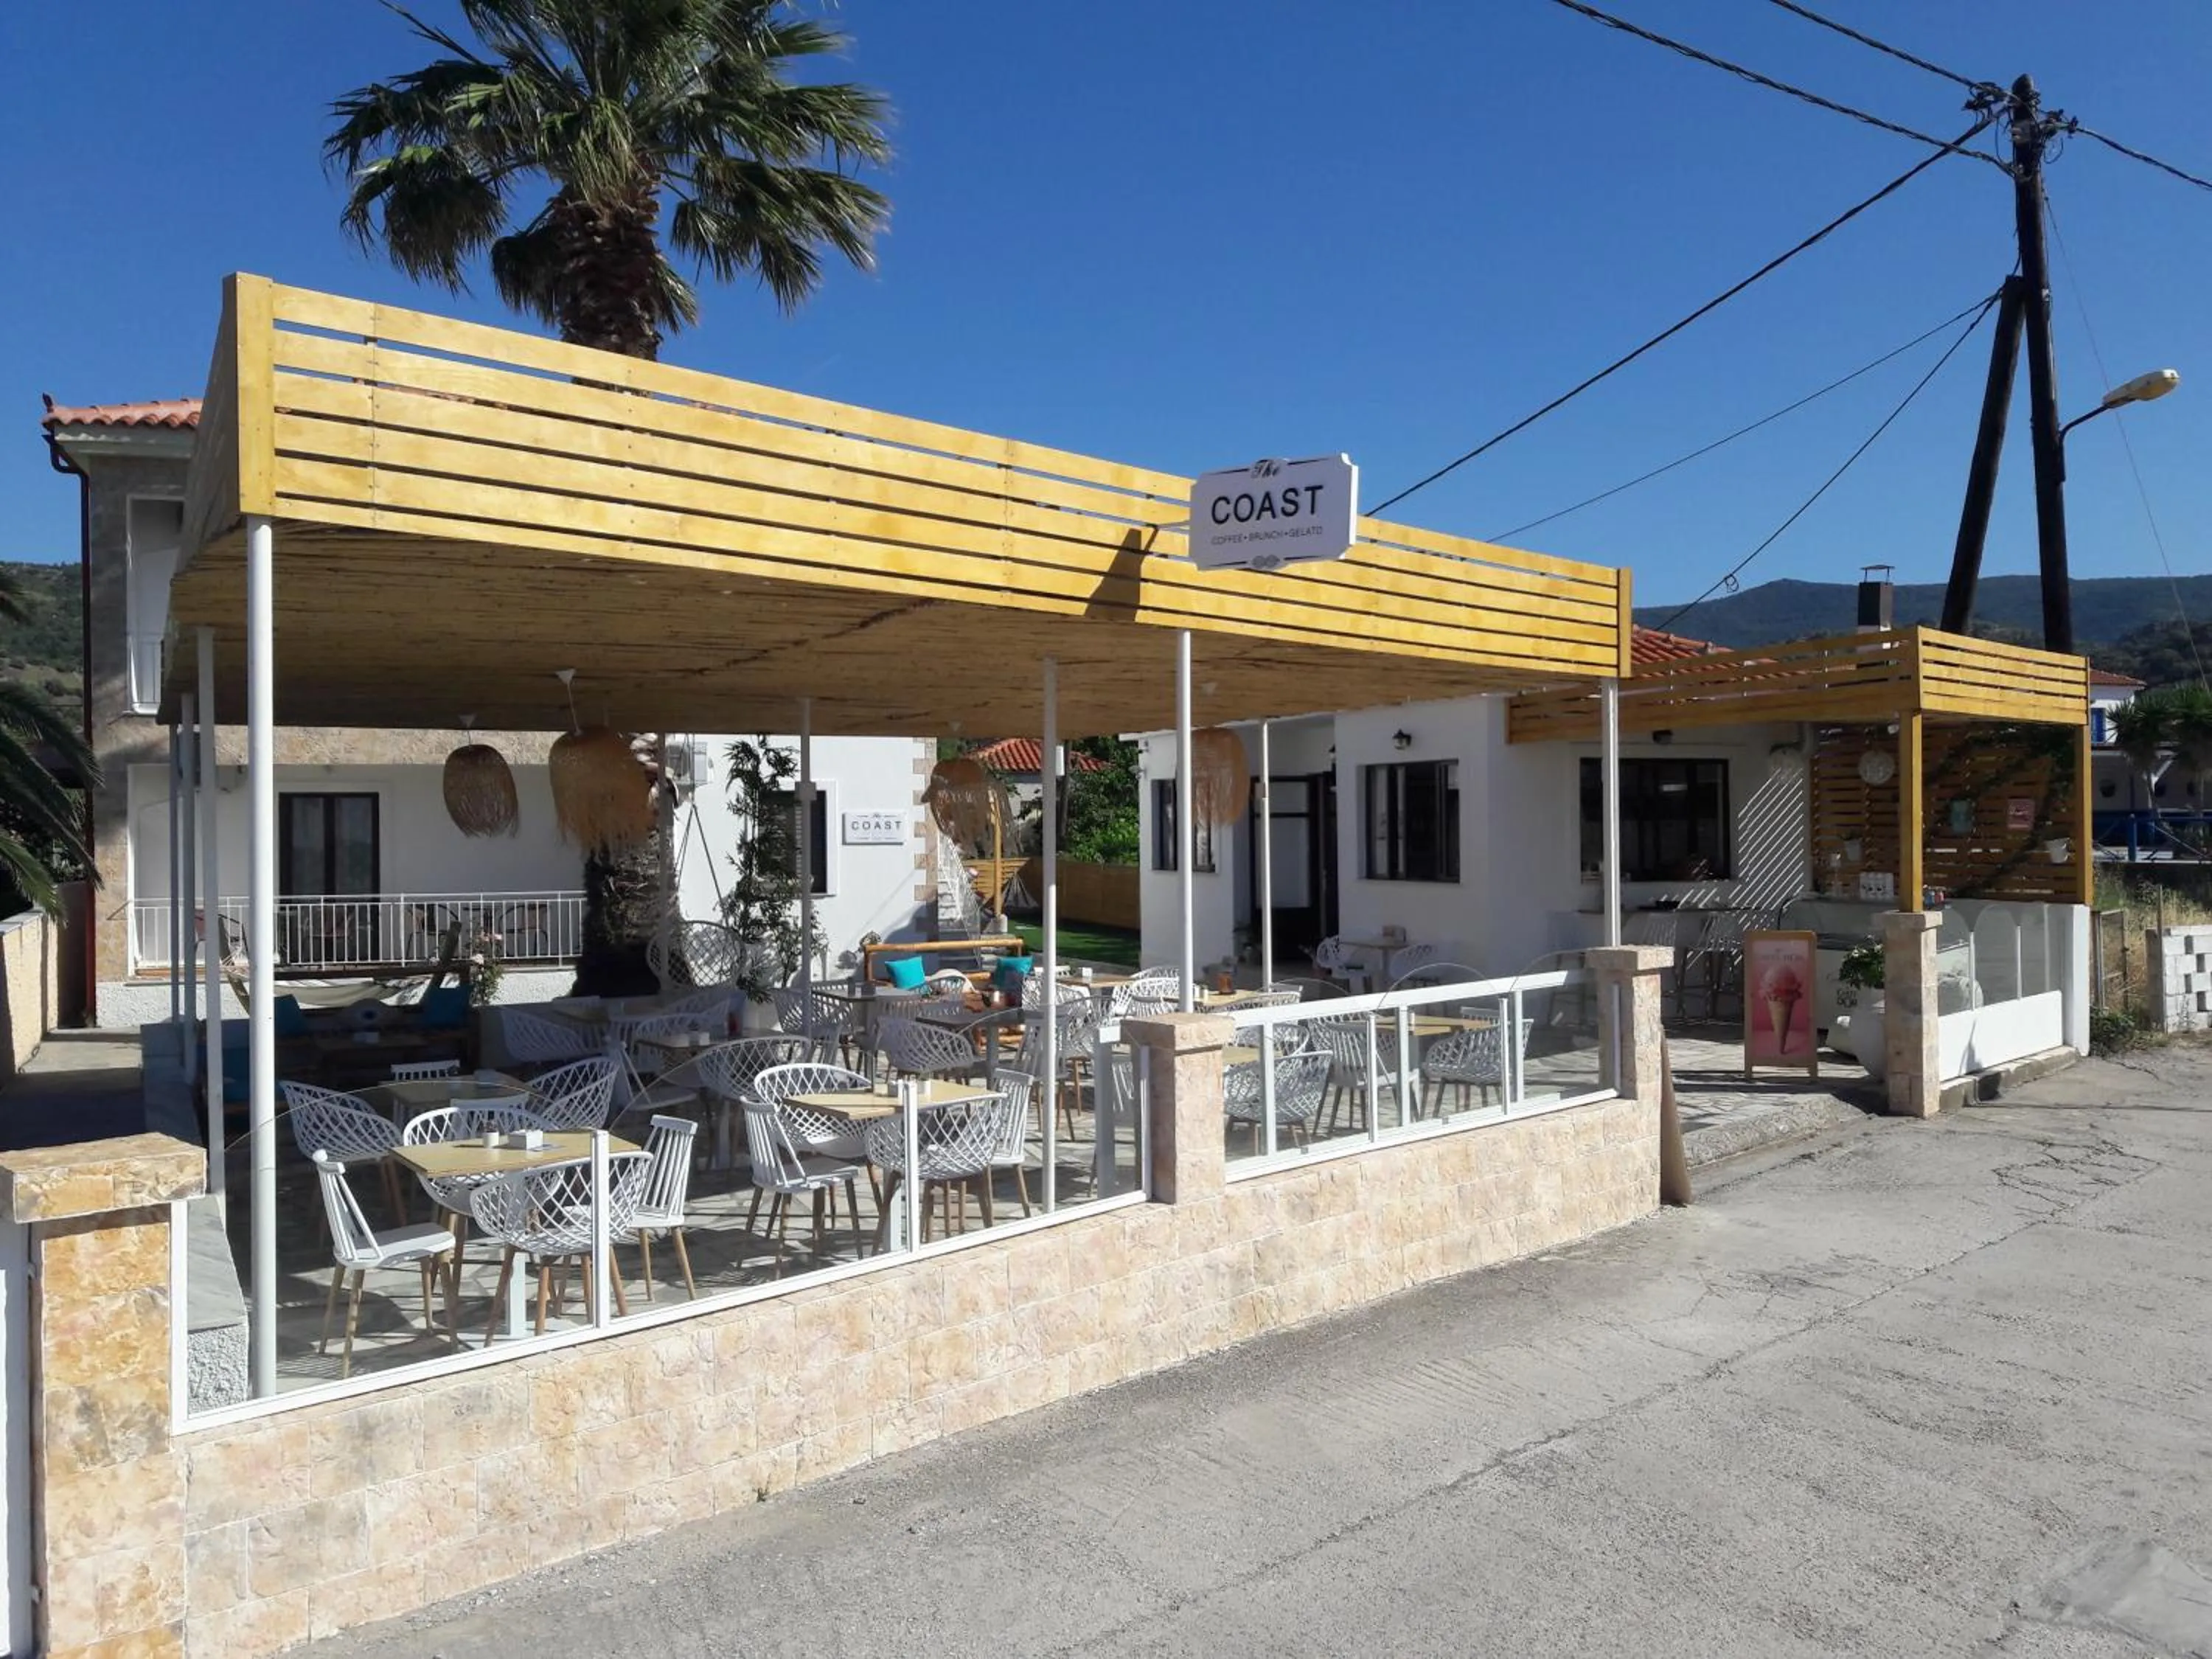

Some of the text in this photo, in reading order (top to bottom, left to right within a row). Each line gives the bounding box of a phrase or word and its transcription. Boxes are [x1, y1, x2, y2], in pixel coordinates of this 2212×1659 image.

[1251, 459, 1281, 479] The
[1211, 484, 1324, 525] COAST
[1211, 526, 1324, 546] COFFEE BRUNCH GELATO
[851, 821, 902, 830] COAST
